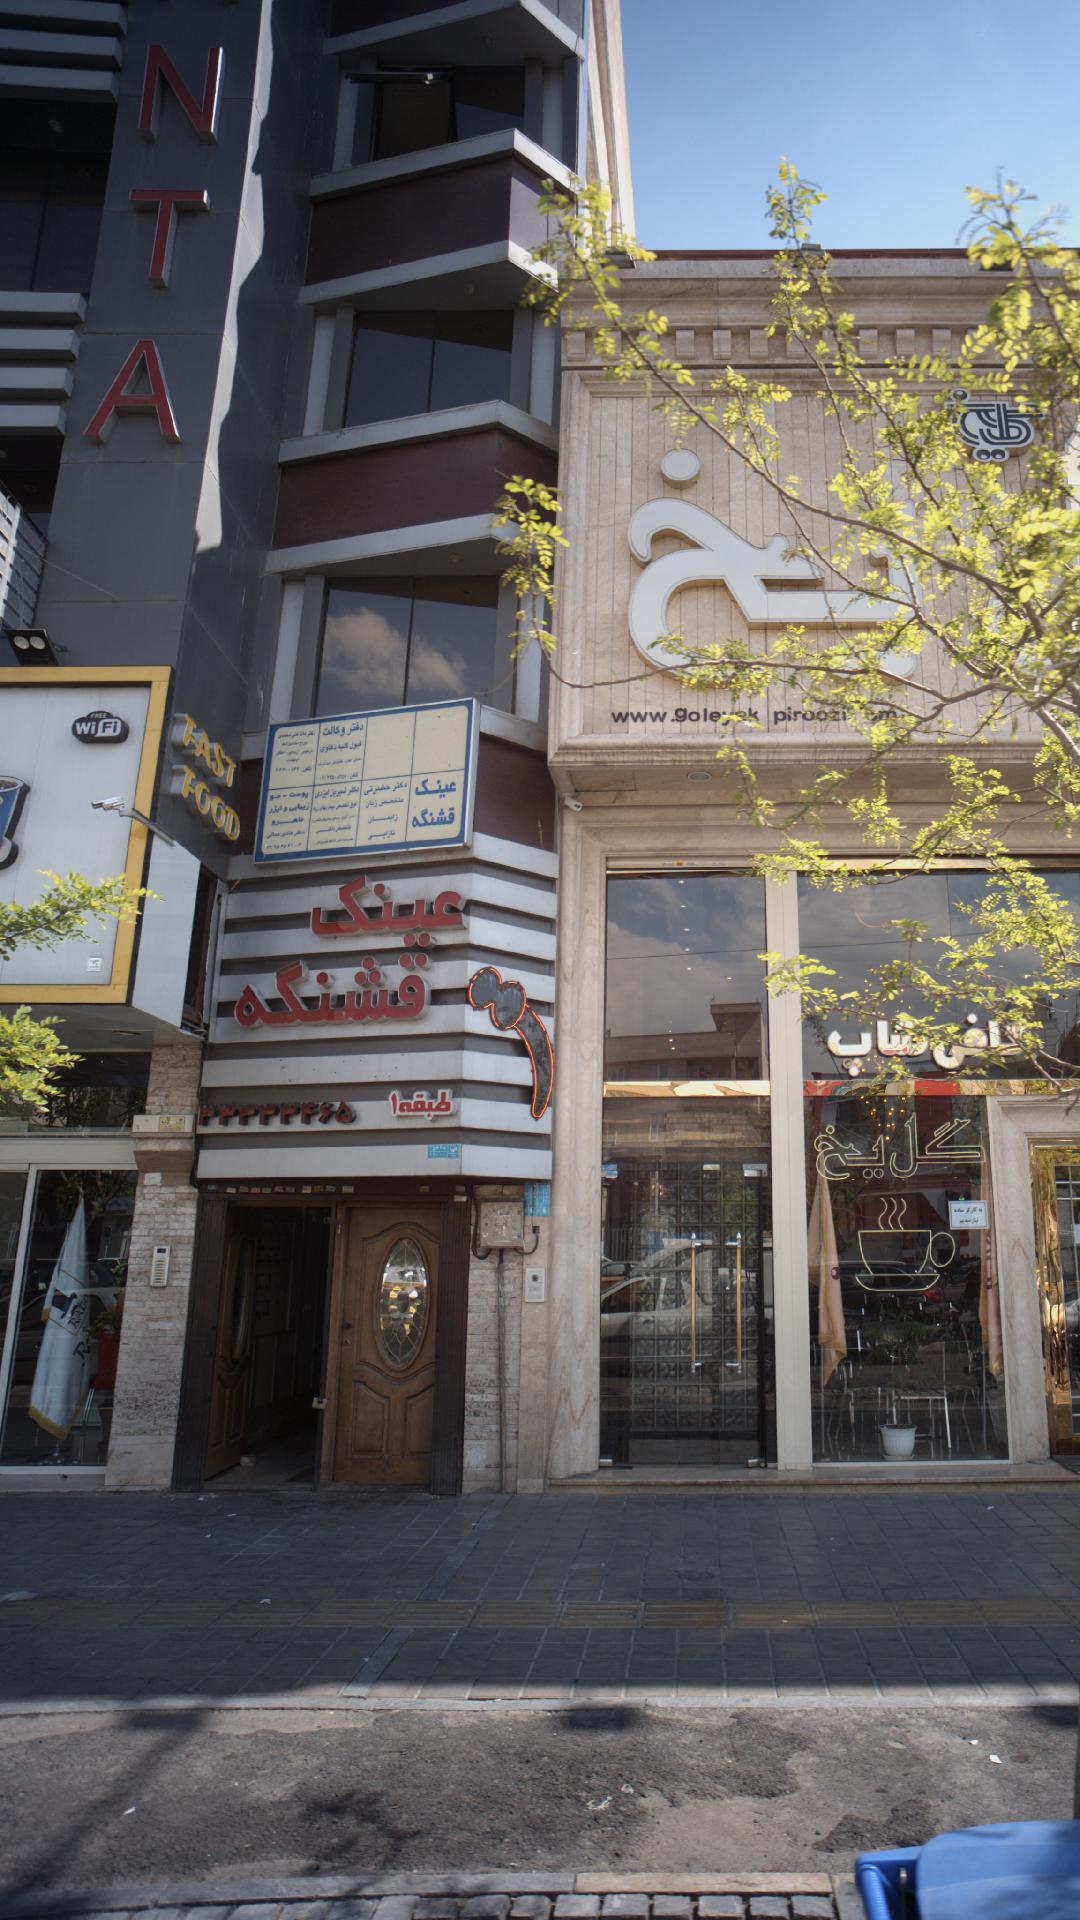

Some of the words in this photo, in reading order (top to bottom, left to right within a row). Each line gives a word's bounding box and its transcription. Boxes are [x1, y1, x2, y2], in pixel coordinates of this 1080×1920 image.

[179, 714, 237, 788] FAST
[322, 724, 346, 737] وکالت
[347, 721, 364, 736] دفتر
[178, 765, 241, 841] FOOD
[391, 781, 408, 792] دکتر
[415, 778, 457, 798] عینک
[411, 807, 455, 828] قشنگه
[311, 875, 466, 947] عینک
[234, 953, 430, 1028] قشنگه
[814, 1125, 886, 1181] یخ
[890, 1112, 986, 1178] گل
